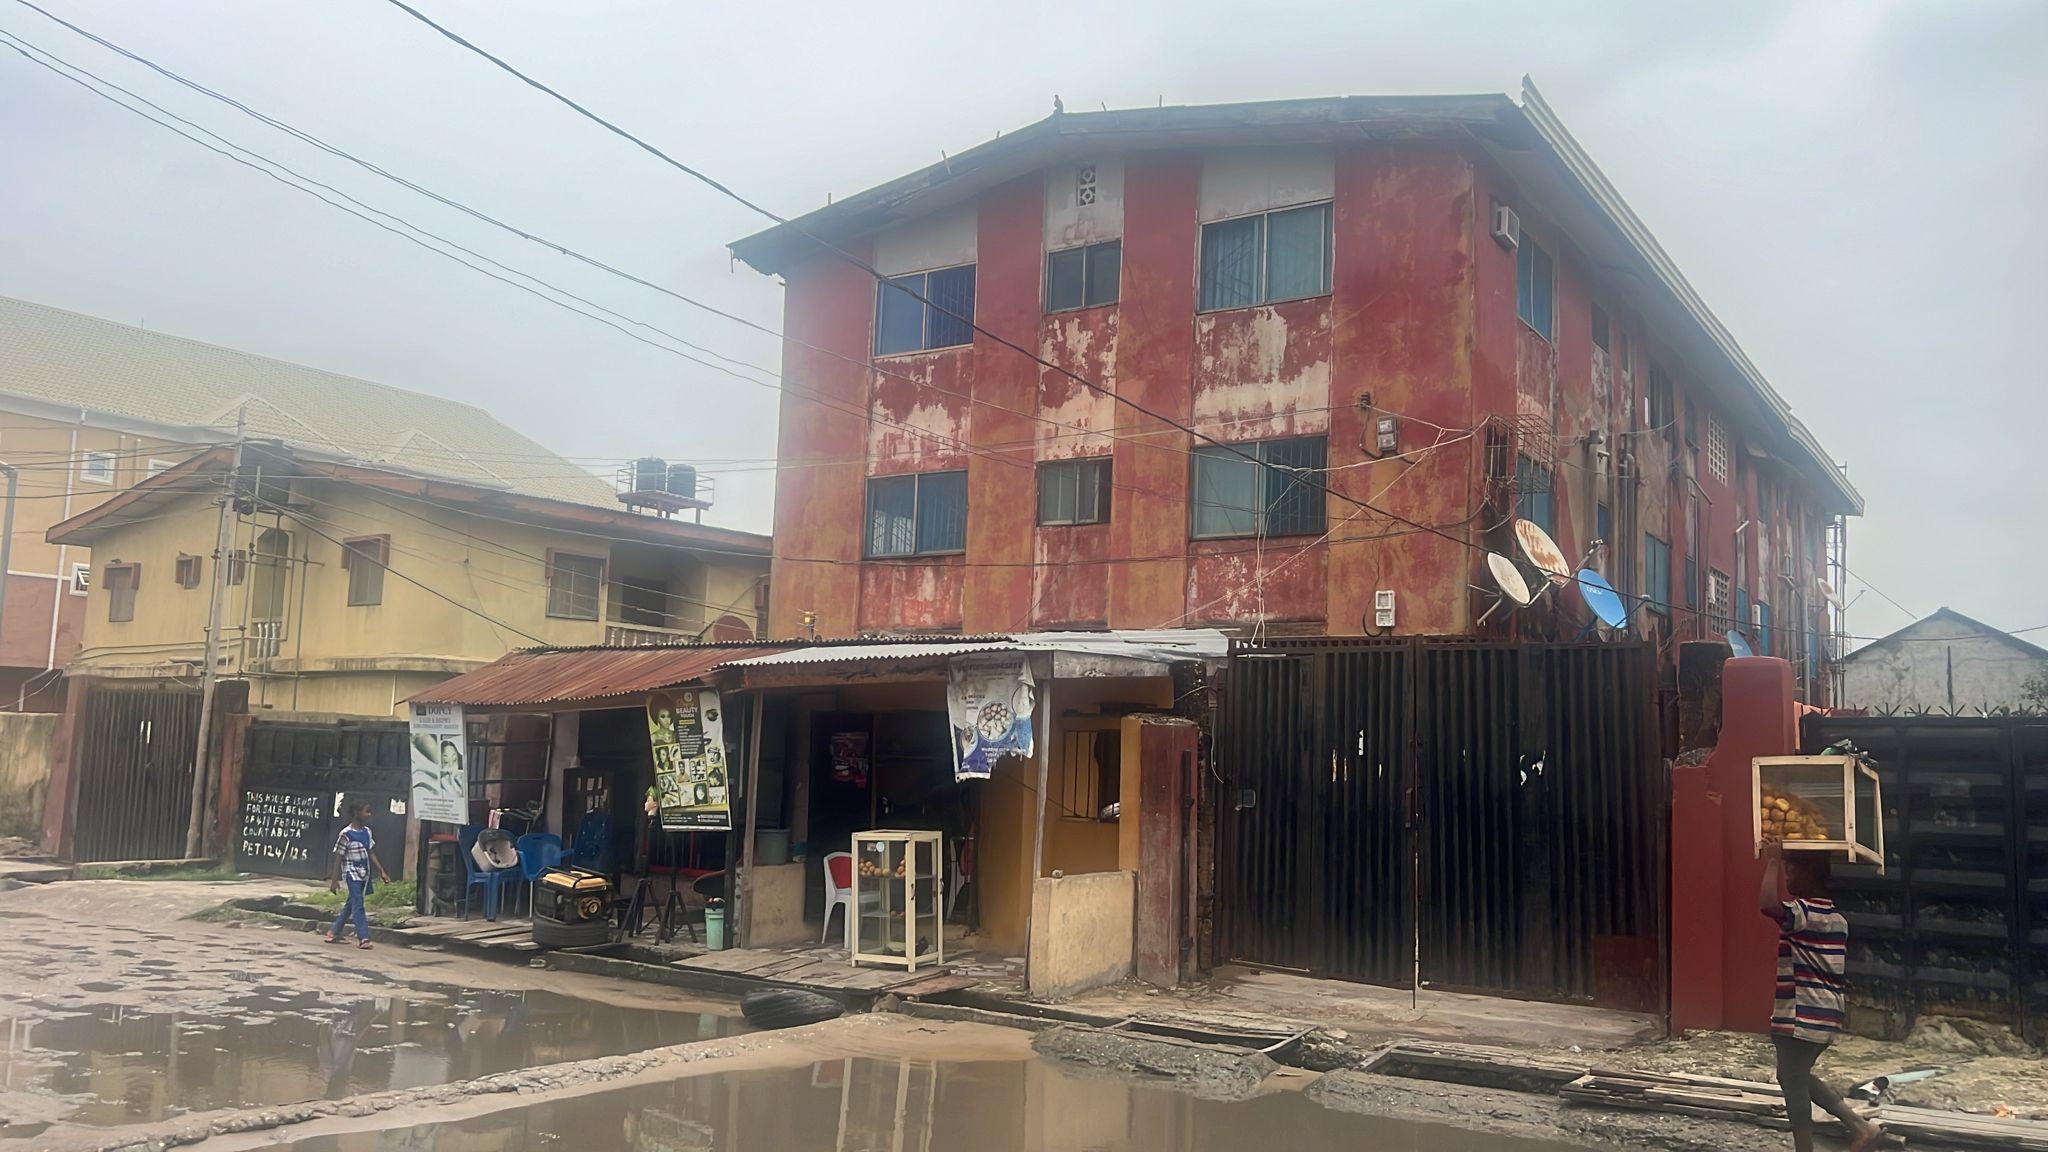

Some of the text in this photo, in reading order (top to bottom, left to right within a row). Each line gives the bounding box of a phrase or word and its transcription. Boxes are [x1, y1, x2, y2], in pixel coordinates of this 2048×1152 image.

[246, 791, 318, 807] THIS HOUSE IS NOT
[246, 803, 261, 814] FOR
[262, 804, 283, 815] SALE
[244, 815, 256, 824] OF
[273, 816, 290, 827] FED
[243, 826, 301, 838] COURT ABUJA
[242, 840, 261, 856] PET
